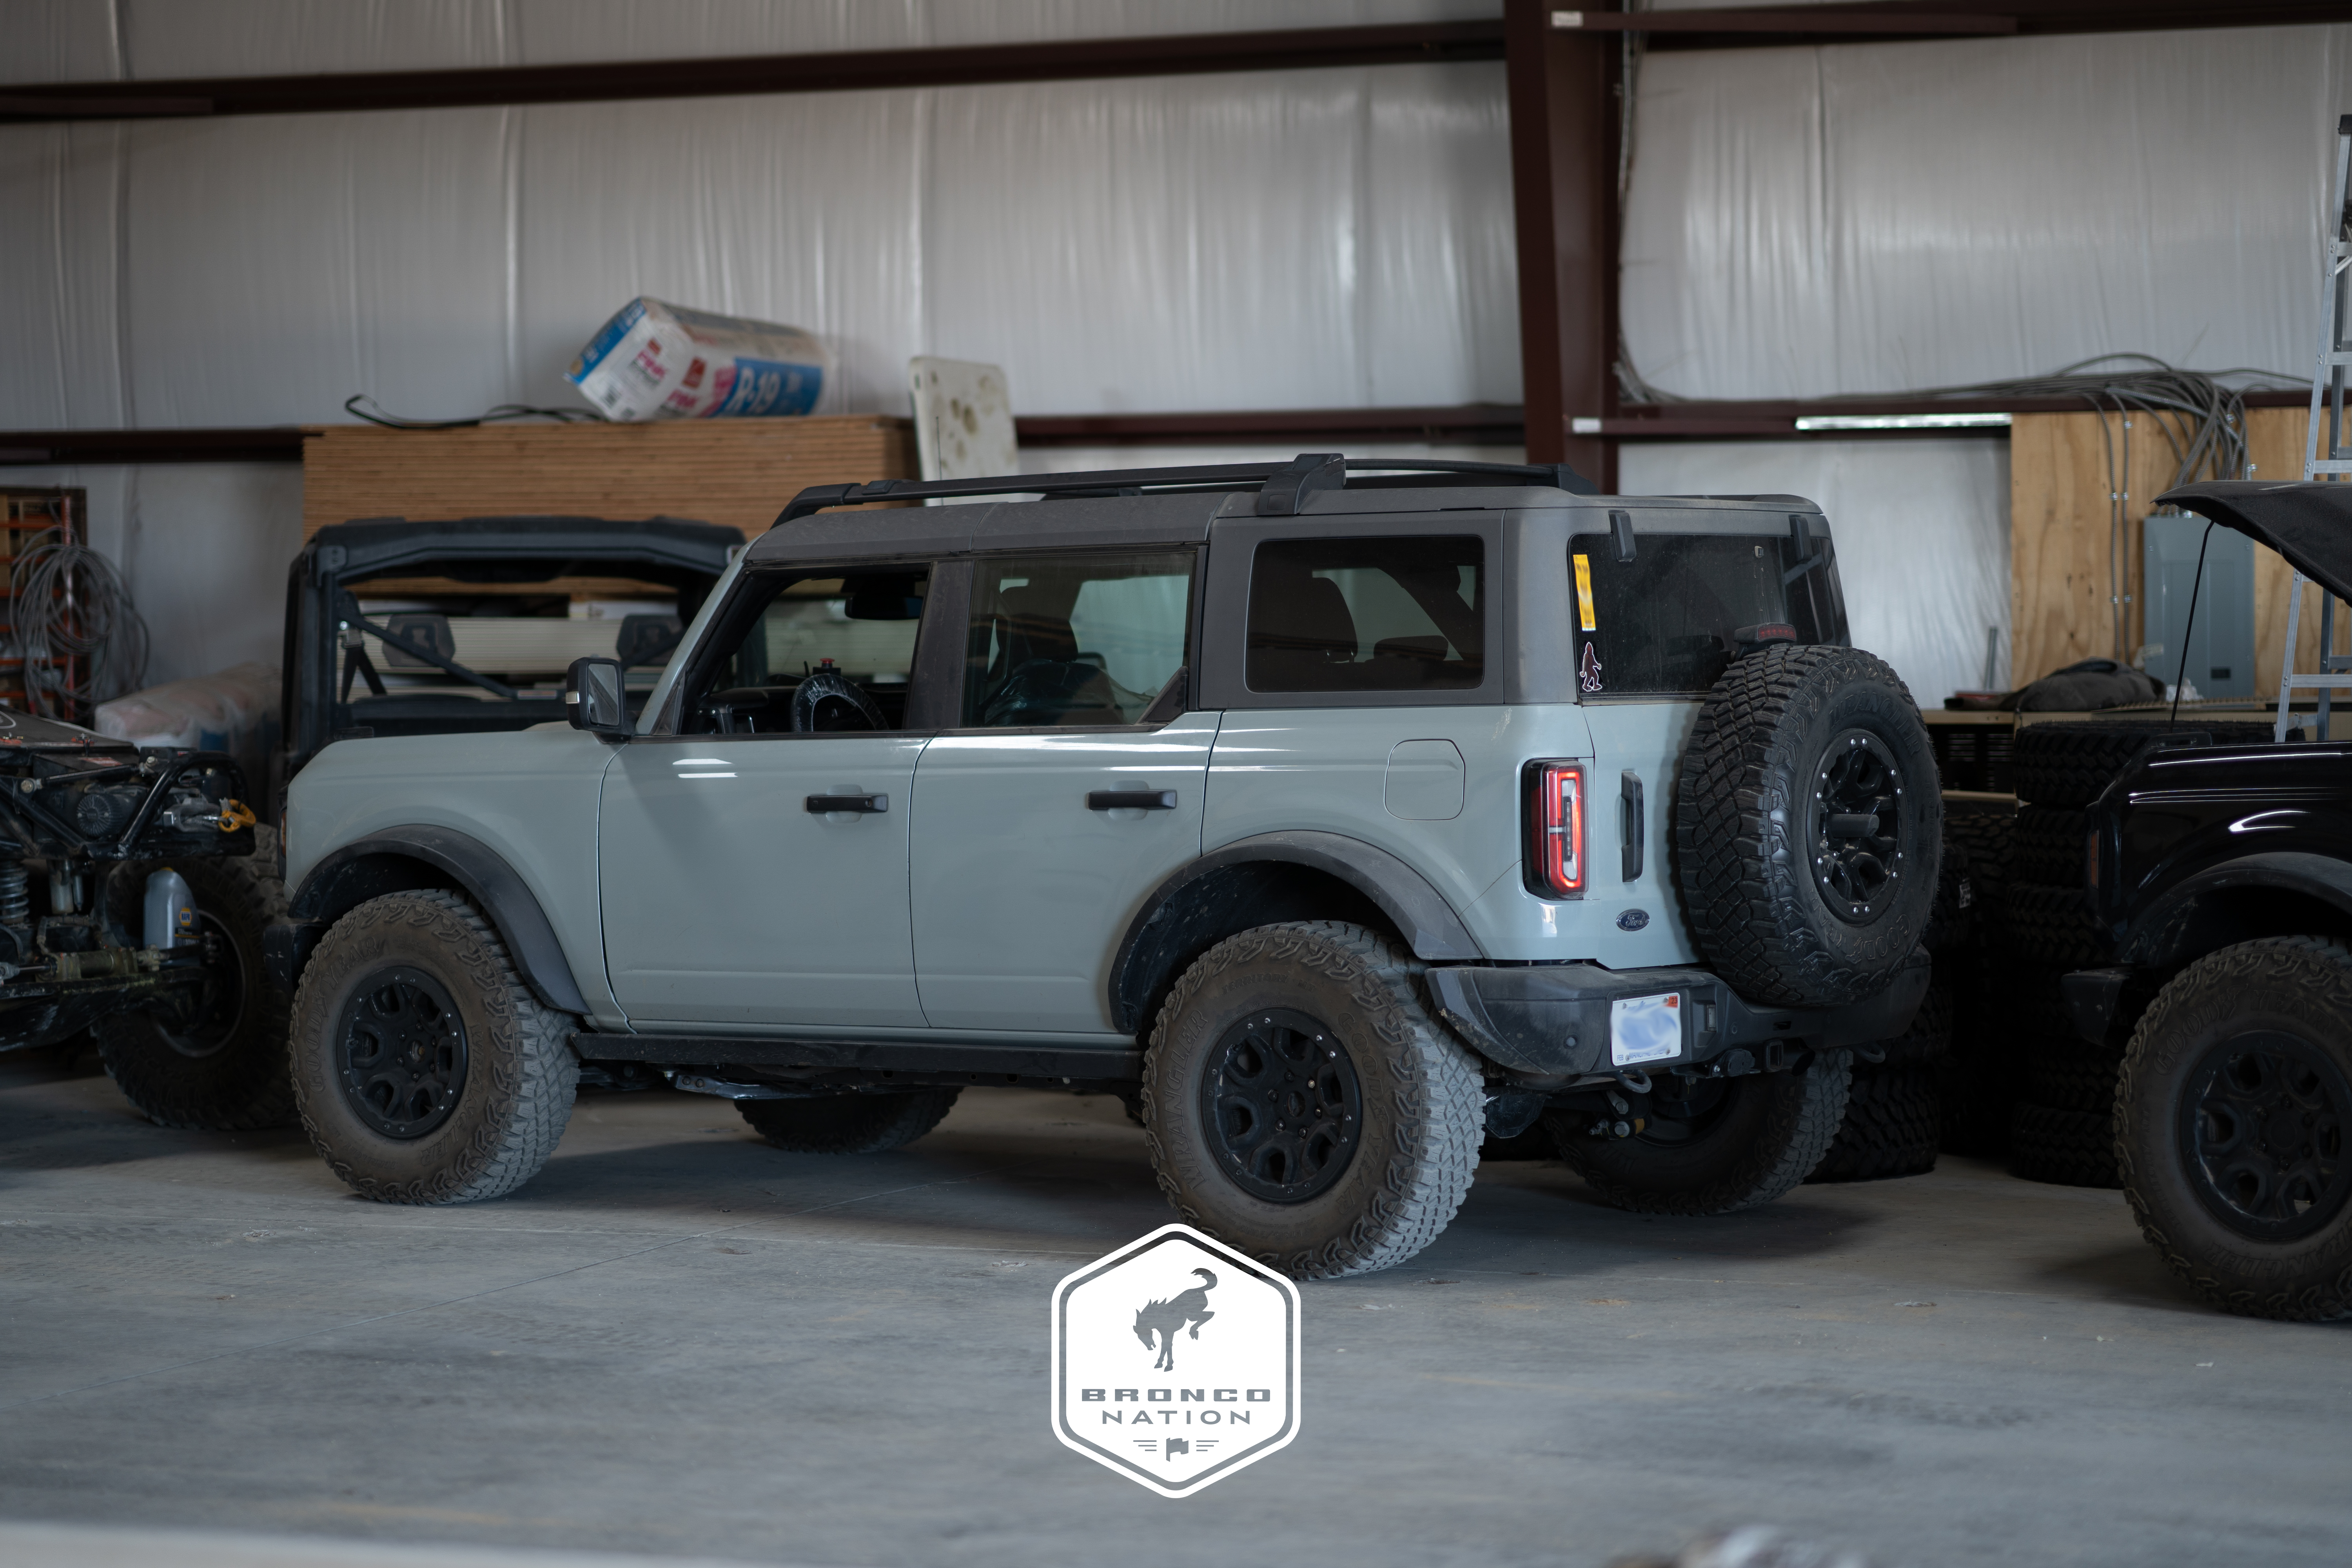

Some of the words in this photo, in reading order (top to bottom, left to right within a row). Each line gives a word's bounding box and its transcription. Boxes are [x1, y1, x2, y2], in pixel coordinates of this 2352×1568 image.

[726, 366, 781, 414] R-19
[1829, 691, 1922, 757] WRANGLER
[1625, 913, 1648, 927] Ford
[421, 1023, 484, 1166] WRANGLER
[1163, 1009, 1209, 1192] WRANGLER
[1337, 1011, 1389, 1216] GOODYEAR
